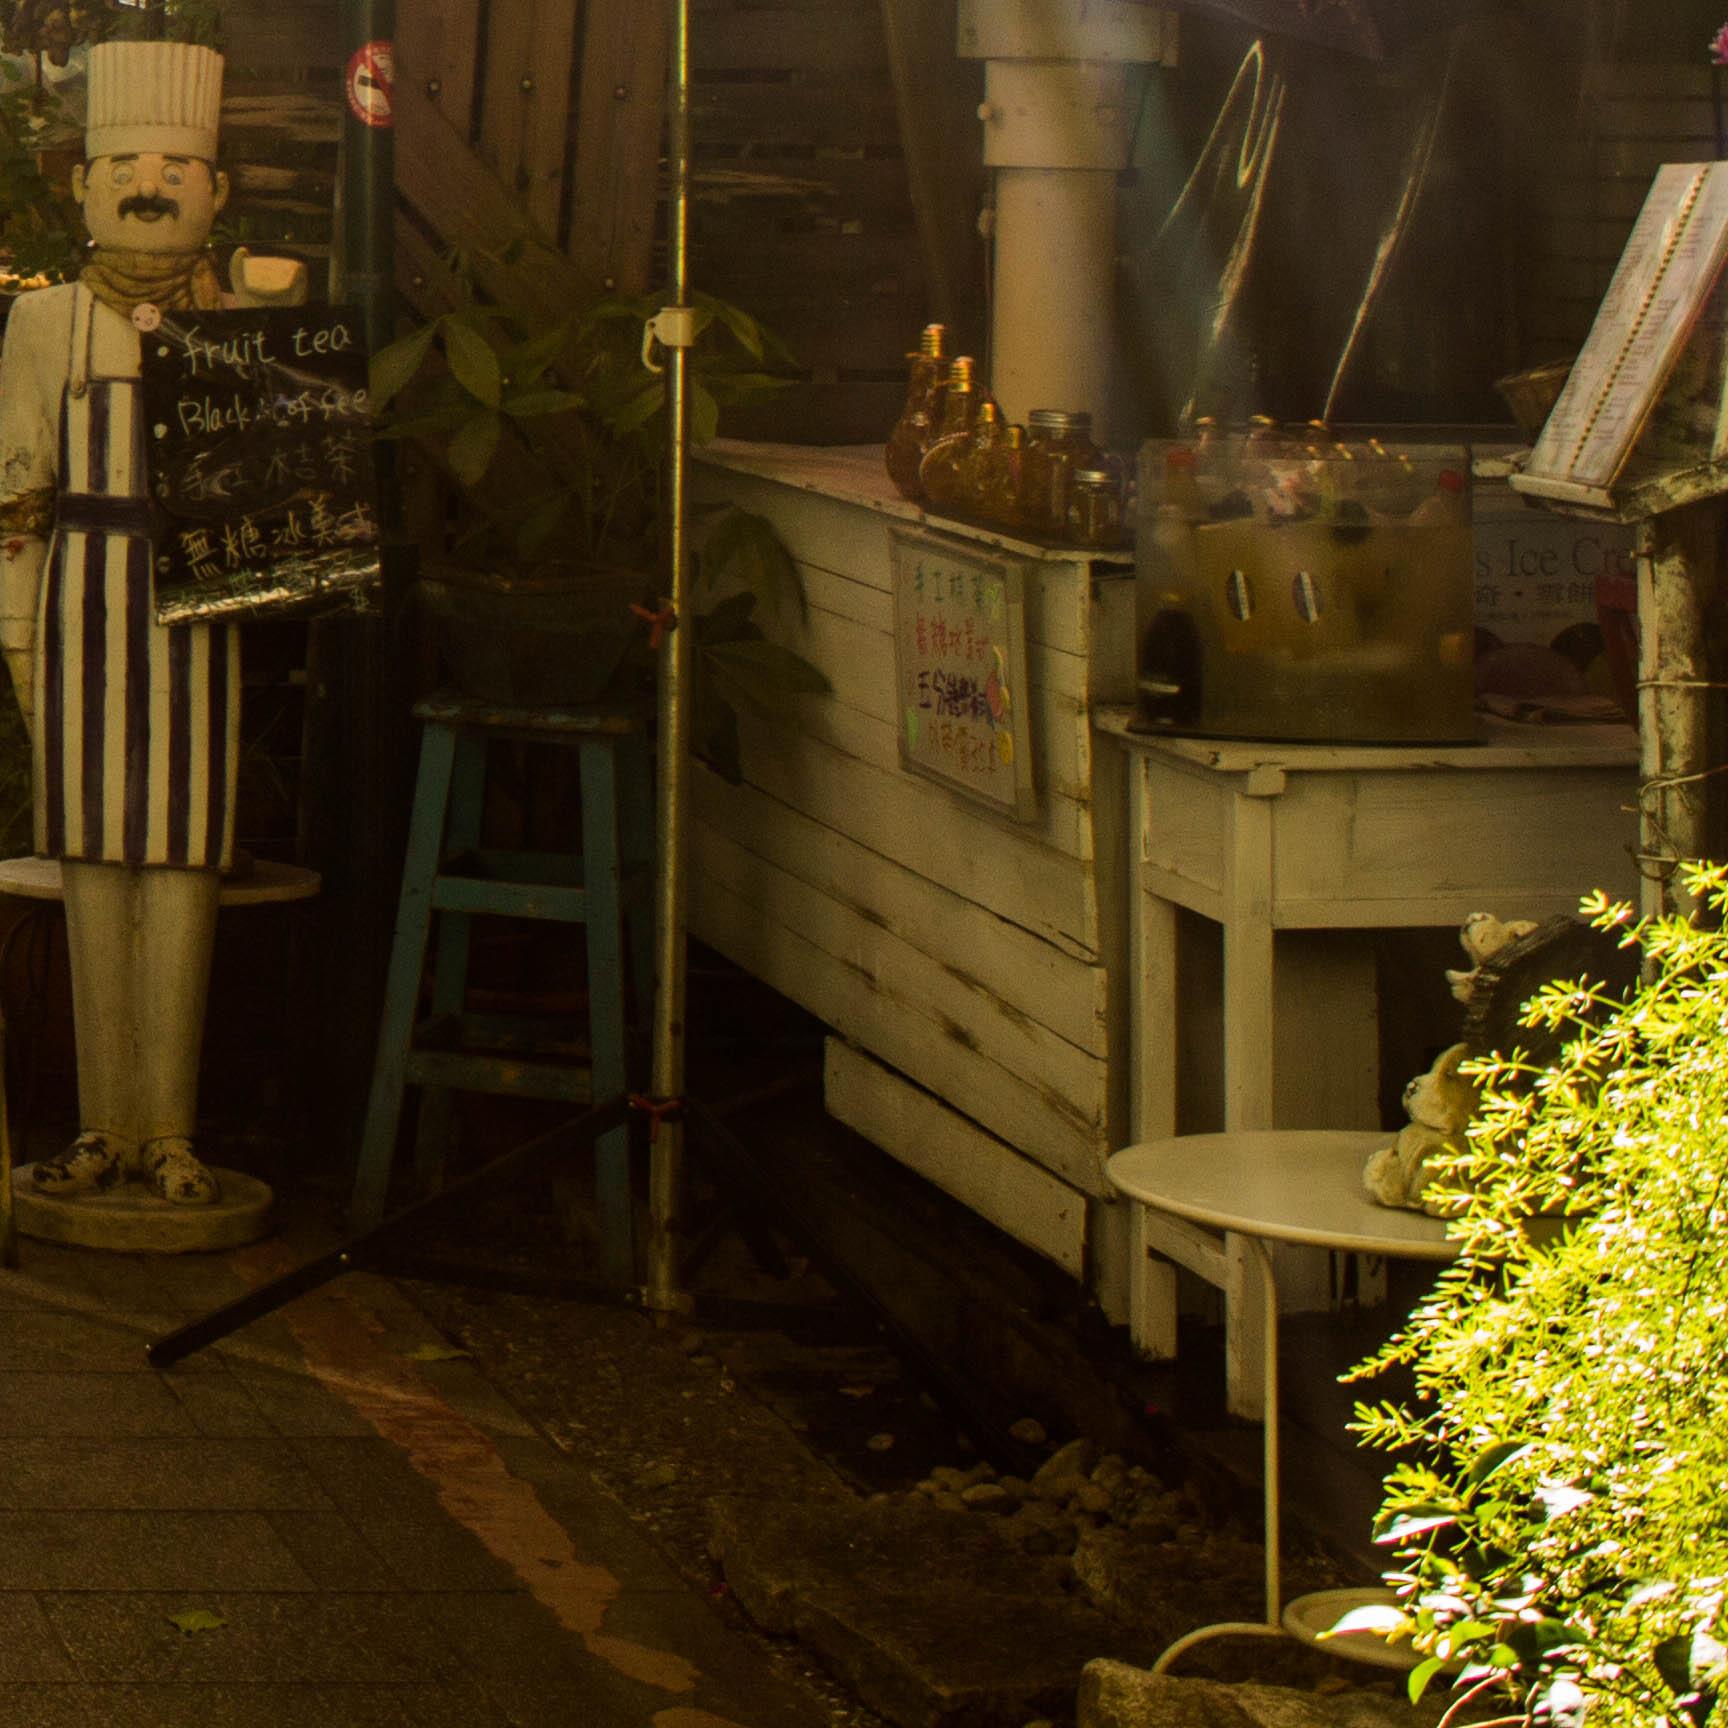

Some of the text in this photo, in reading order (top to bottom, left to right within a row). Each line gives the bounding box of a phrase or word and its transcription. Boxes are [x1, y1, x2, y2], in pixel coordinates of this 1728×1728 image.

[182, 323, 352, 376] fruit tea
[177, 392, 252, 437] Black
[1504, 537, 1559, 577] Ice
[1572, 536, 1637, 577] Cre
